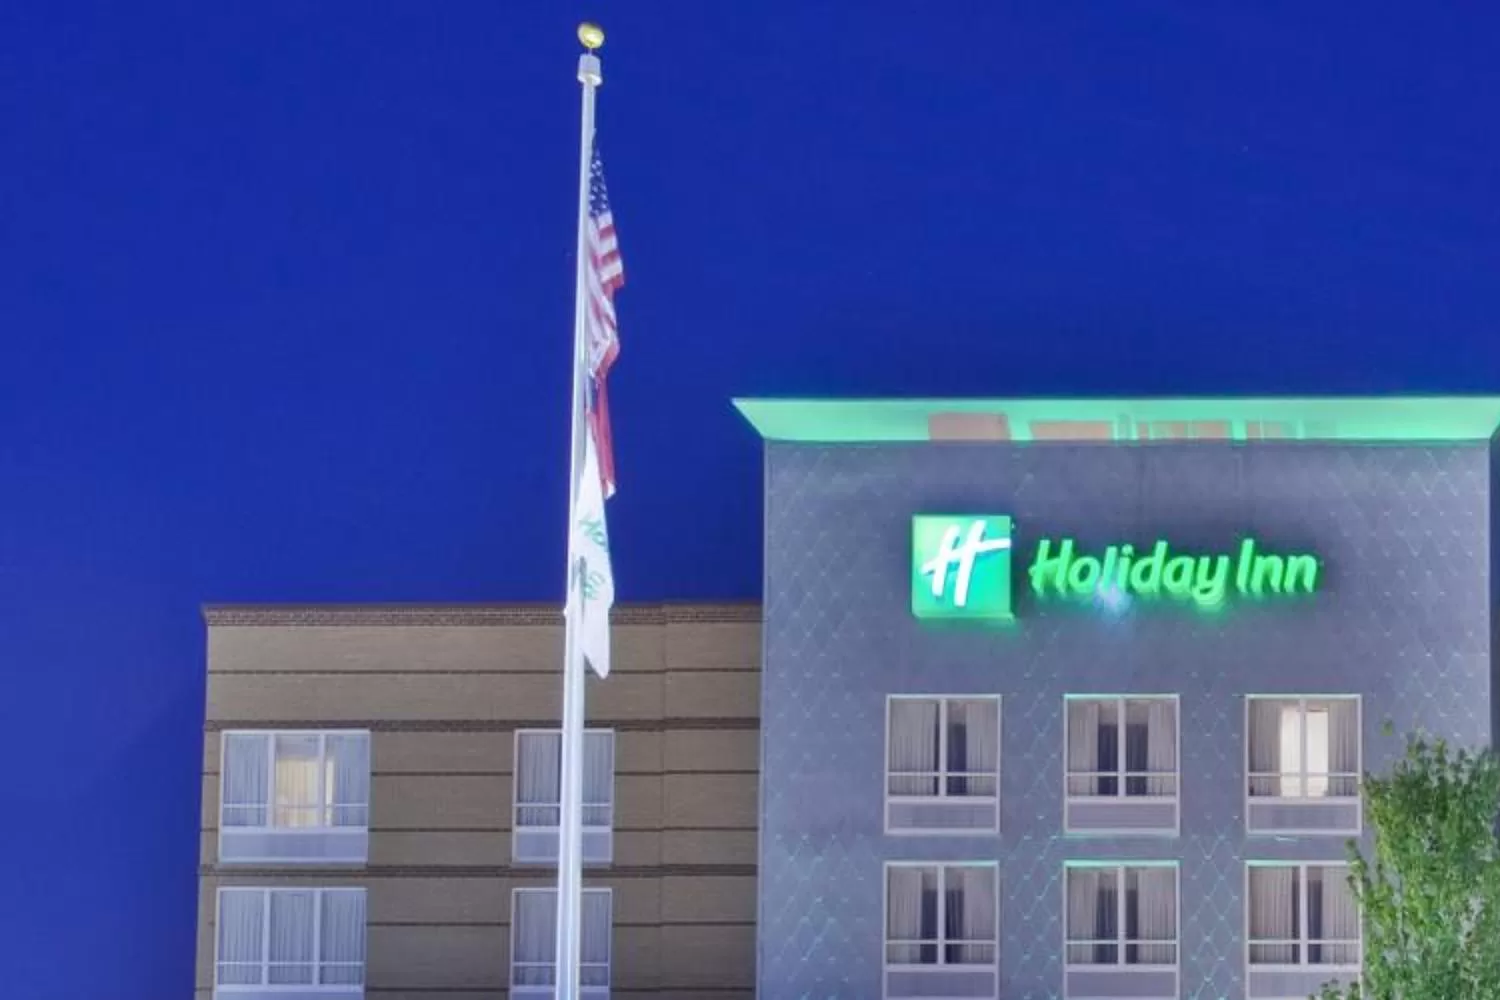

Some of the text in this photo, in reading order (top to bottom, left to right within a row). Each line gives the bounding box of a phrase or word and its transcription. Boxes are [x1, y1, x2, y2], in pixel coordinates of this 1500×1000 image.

[921, 519, 1011, 607] H
[1029, 538, 1318, 603] Holiday Inn
